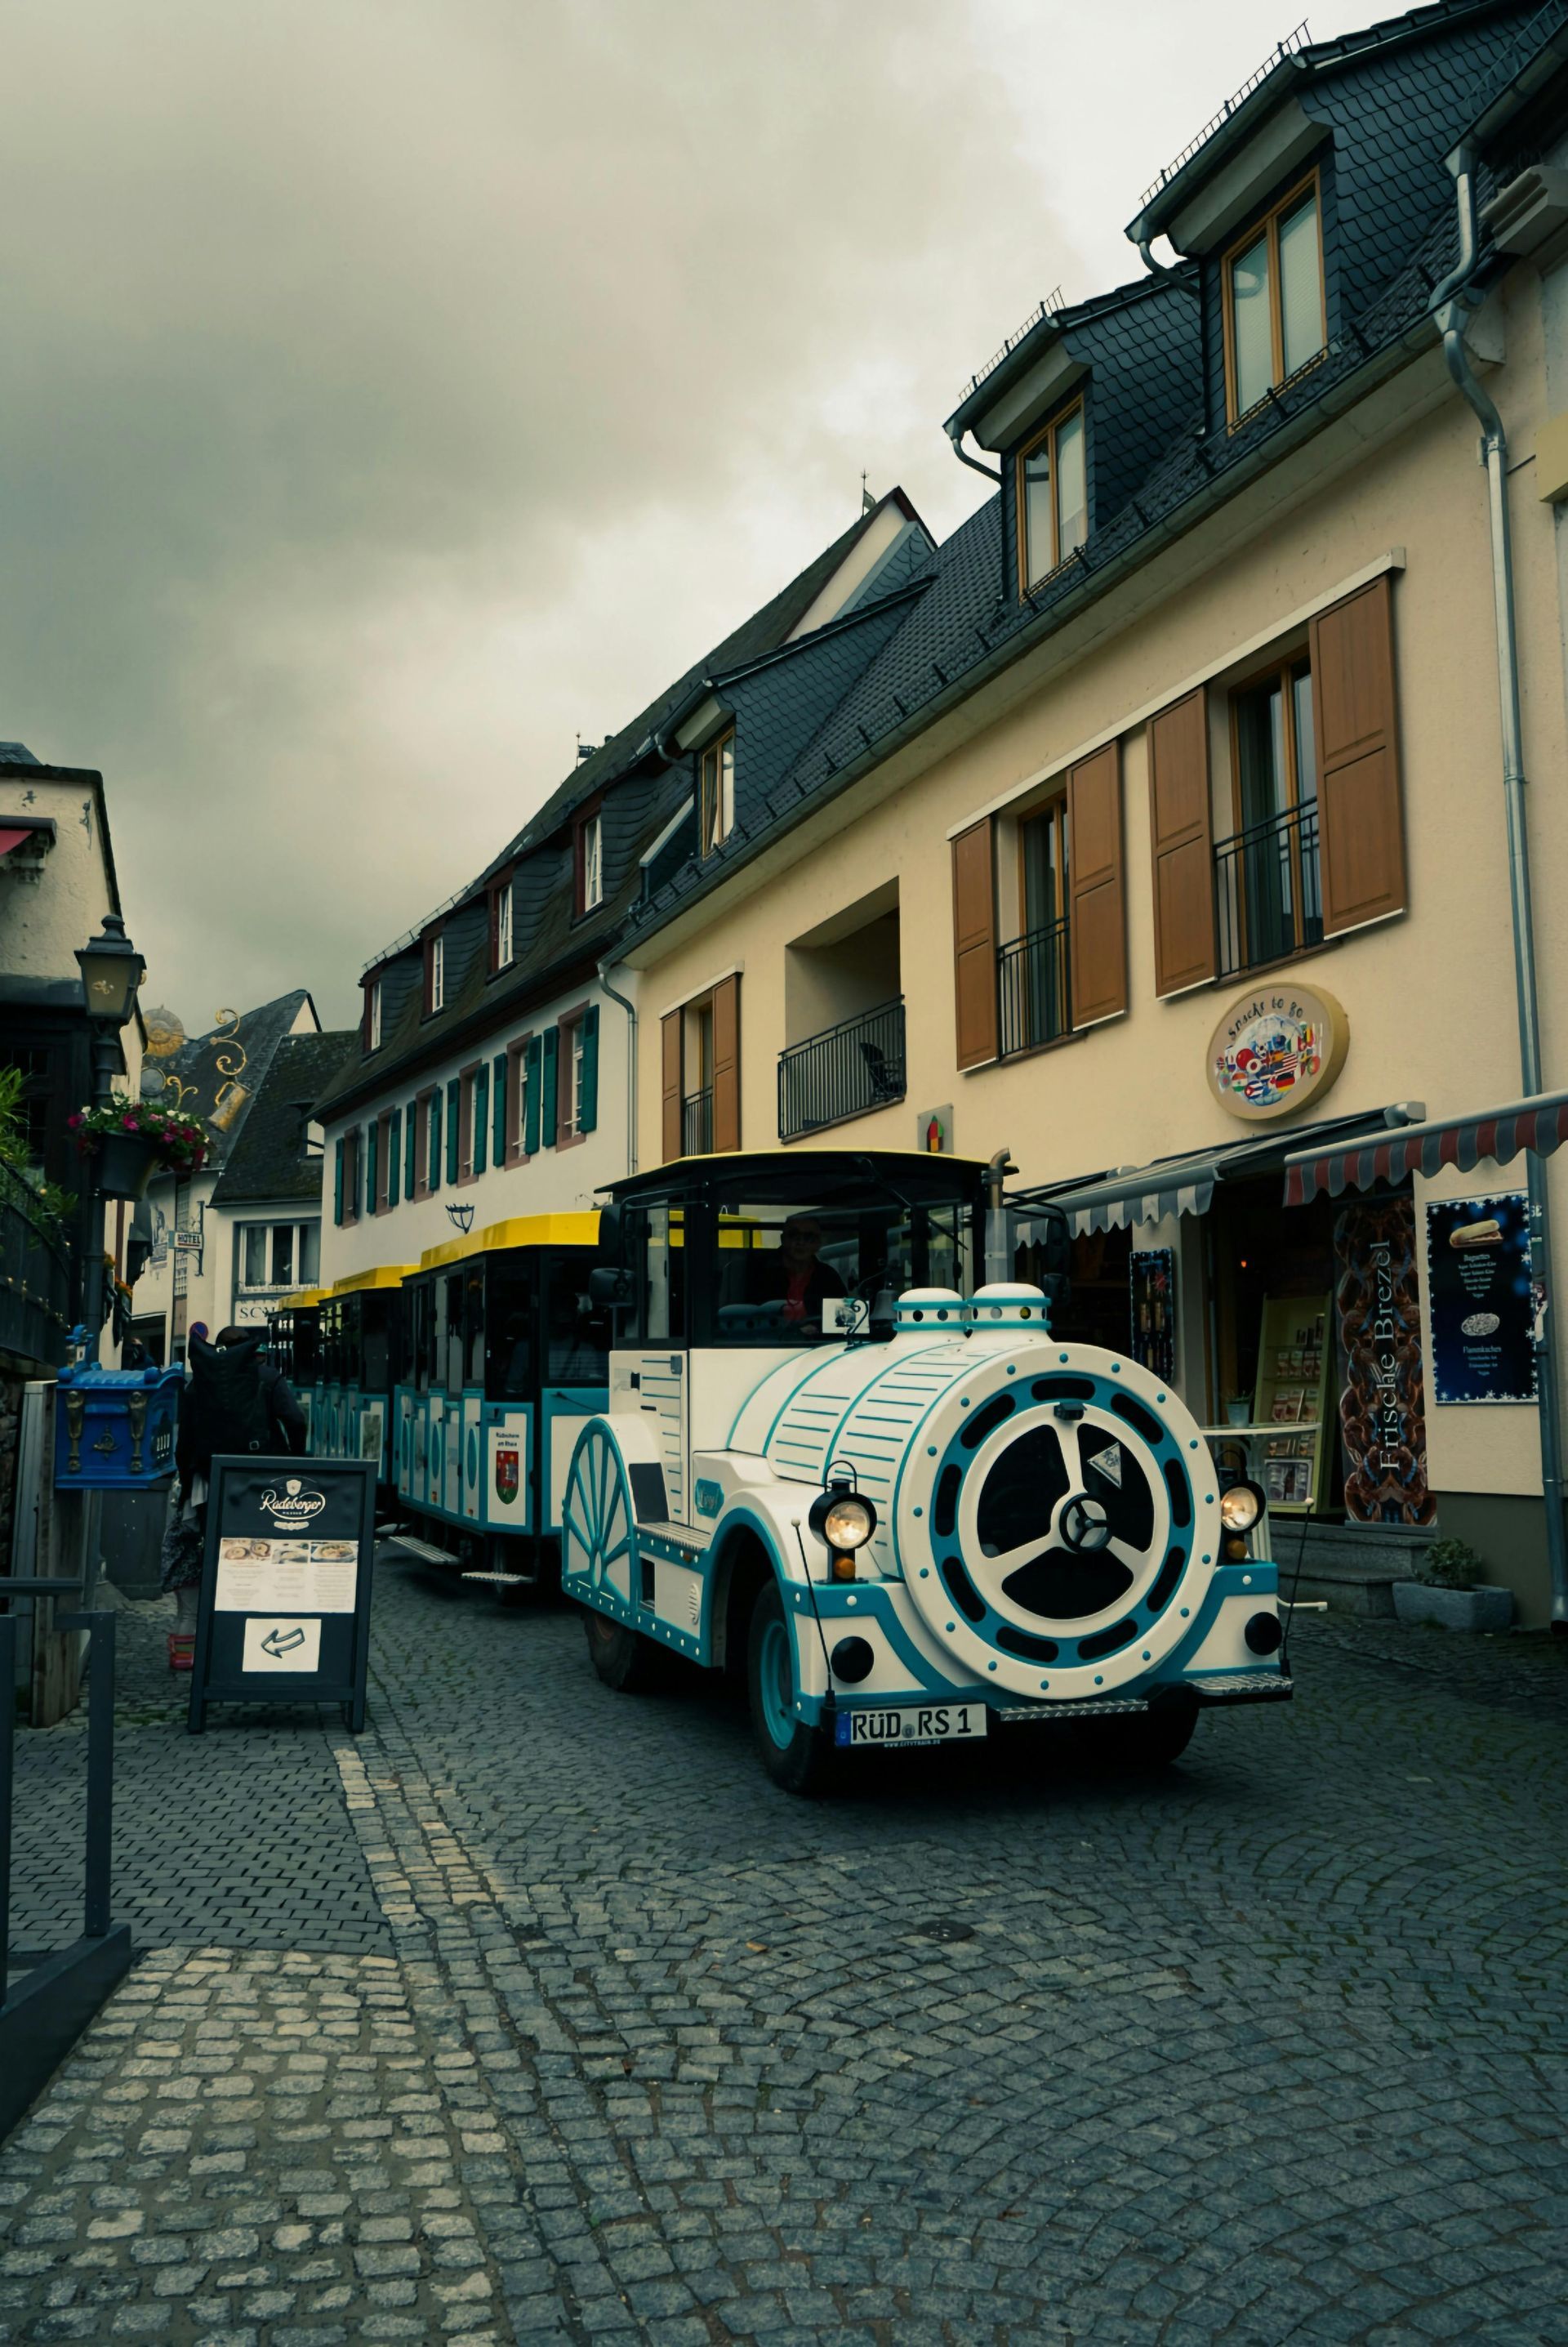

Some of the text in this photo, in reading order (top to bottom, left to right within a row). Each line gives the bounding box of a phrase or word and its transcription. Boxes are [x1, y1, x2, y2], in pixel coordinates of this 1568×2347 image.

[1272, 996, 1284, 1009] to
[177, 1234, 201, 1244] HOTEL
[1370, 1240, 1400, 1470] Frische Brezel
[259, 1489, 325, 1515] Radeberger
[853, 1712, 901, 1741] RÜD
